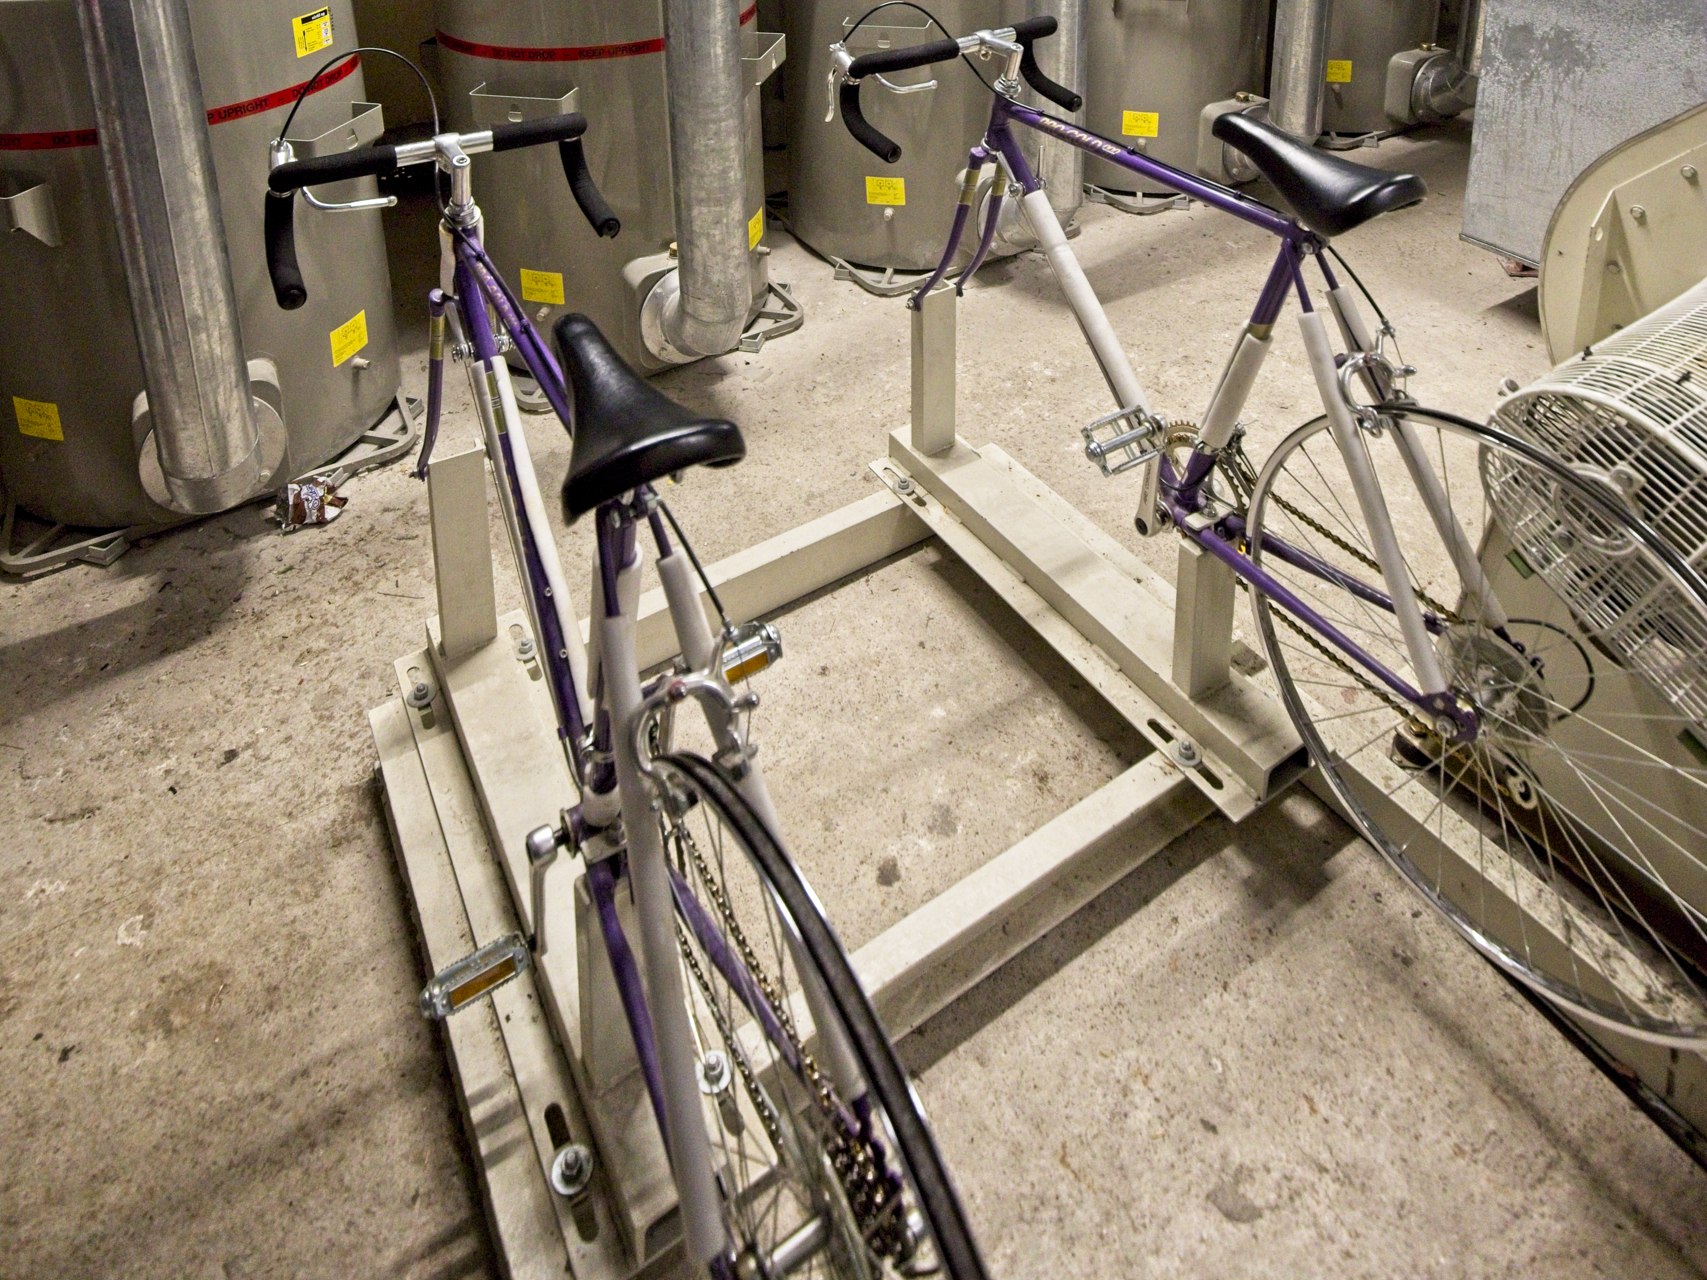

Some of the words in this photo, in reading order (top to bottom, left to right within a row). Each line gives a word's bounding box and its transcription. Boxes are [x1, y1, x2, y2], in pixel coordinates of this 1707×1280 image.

[507, 50, 525, 59] NOT
[528, 50, 556, 59] DROP
[578, 48, 605, 58] KEEP
[606, 43, 651, 56] UPRIGHT
[218, 98, 270, 120] UPRIGHT
[325, 70, 342, 84] DROP
[52, 134, 72, 145] DO
[76, 132, 97, 144] NO
